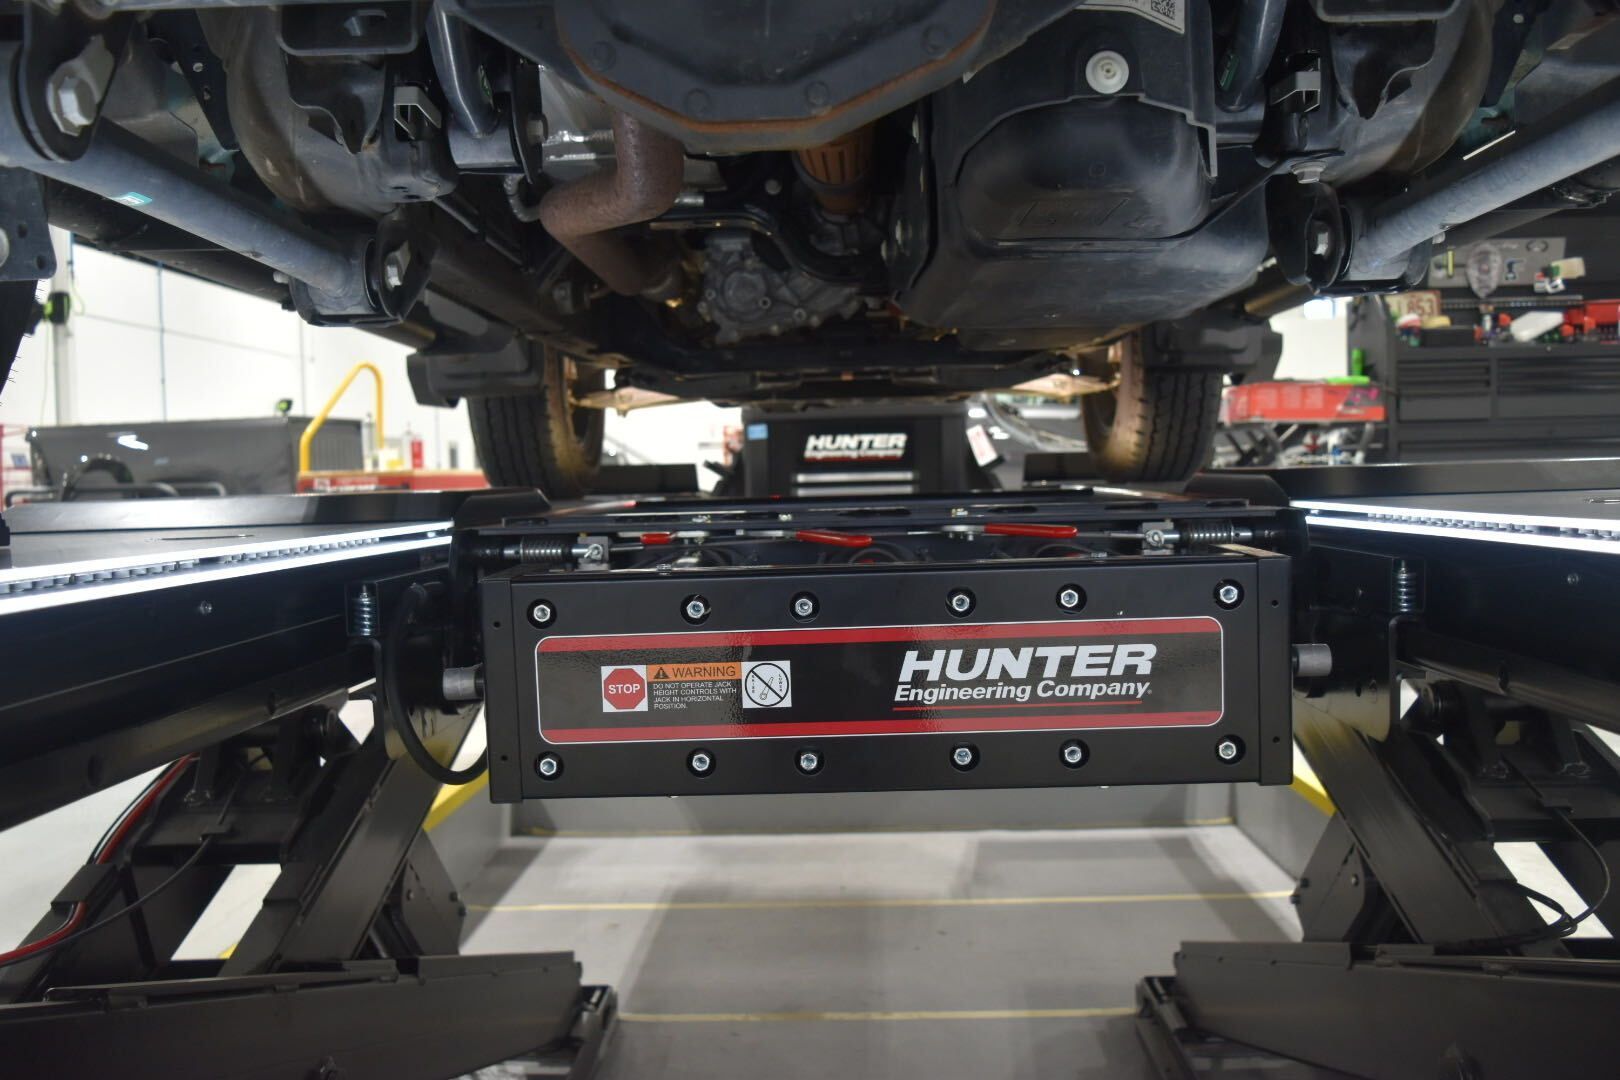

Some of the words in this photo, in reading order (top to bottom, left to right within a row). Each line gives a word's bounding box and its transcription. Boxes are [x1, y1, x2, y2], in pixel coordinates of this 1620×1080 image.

[805, 433, 907, 450] HUNTER
[898, 643, 1157, 683] HUNTER
[672, 666, 736, 678] WARNING
[608, 684, 641, 695] STOP
[680, 688, 718, 696] CONTROLS
[894, 681, 1031, 705] Engineering
[681, 694, 723, 702] HORIZONTAL
